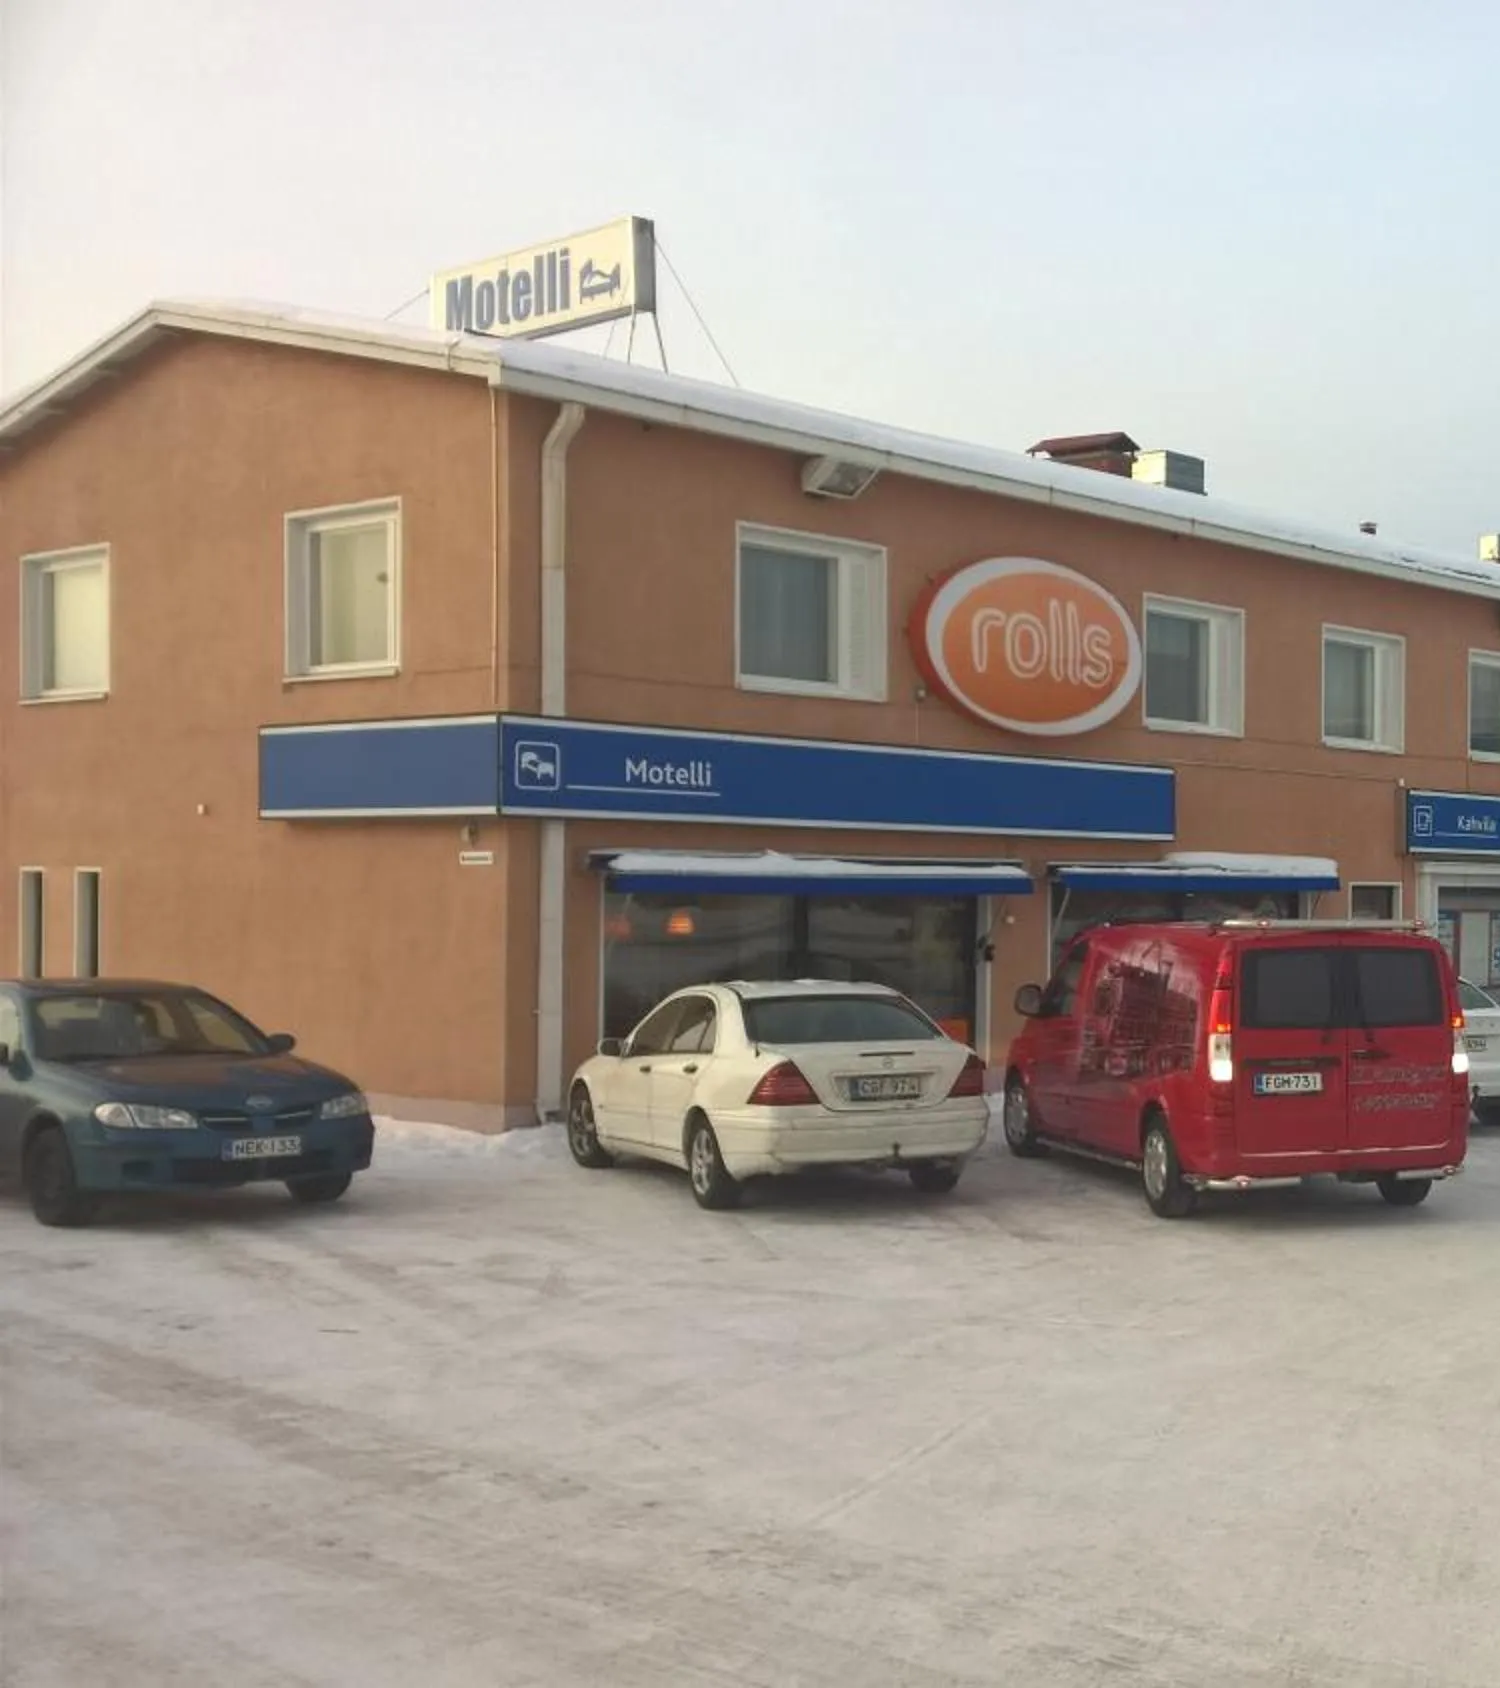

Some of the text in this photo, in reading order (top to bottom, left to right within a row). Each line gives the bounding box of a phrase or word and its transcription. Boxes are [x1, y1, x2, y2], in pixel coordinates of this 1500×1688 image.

[445, 247, 571, 331] Motelli
[970, 597, 1114, 689] rolls
[624, 757, 713, 787] Motelli
[1456, 815, 1498, 832] Kahvila
[1265, 1075, 1317, 1089] FGM-731
